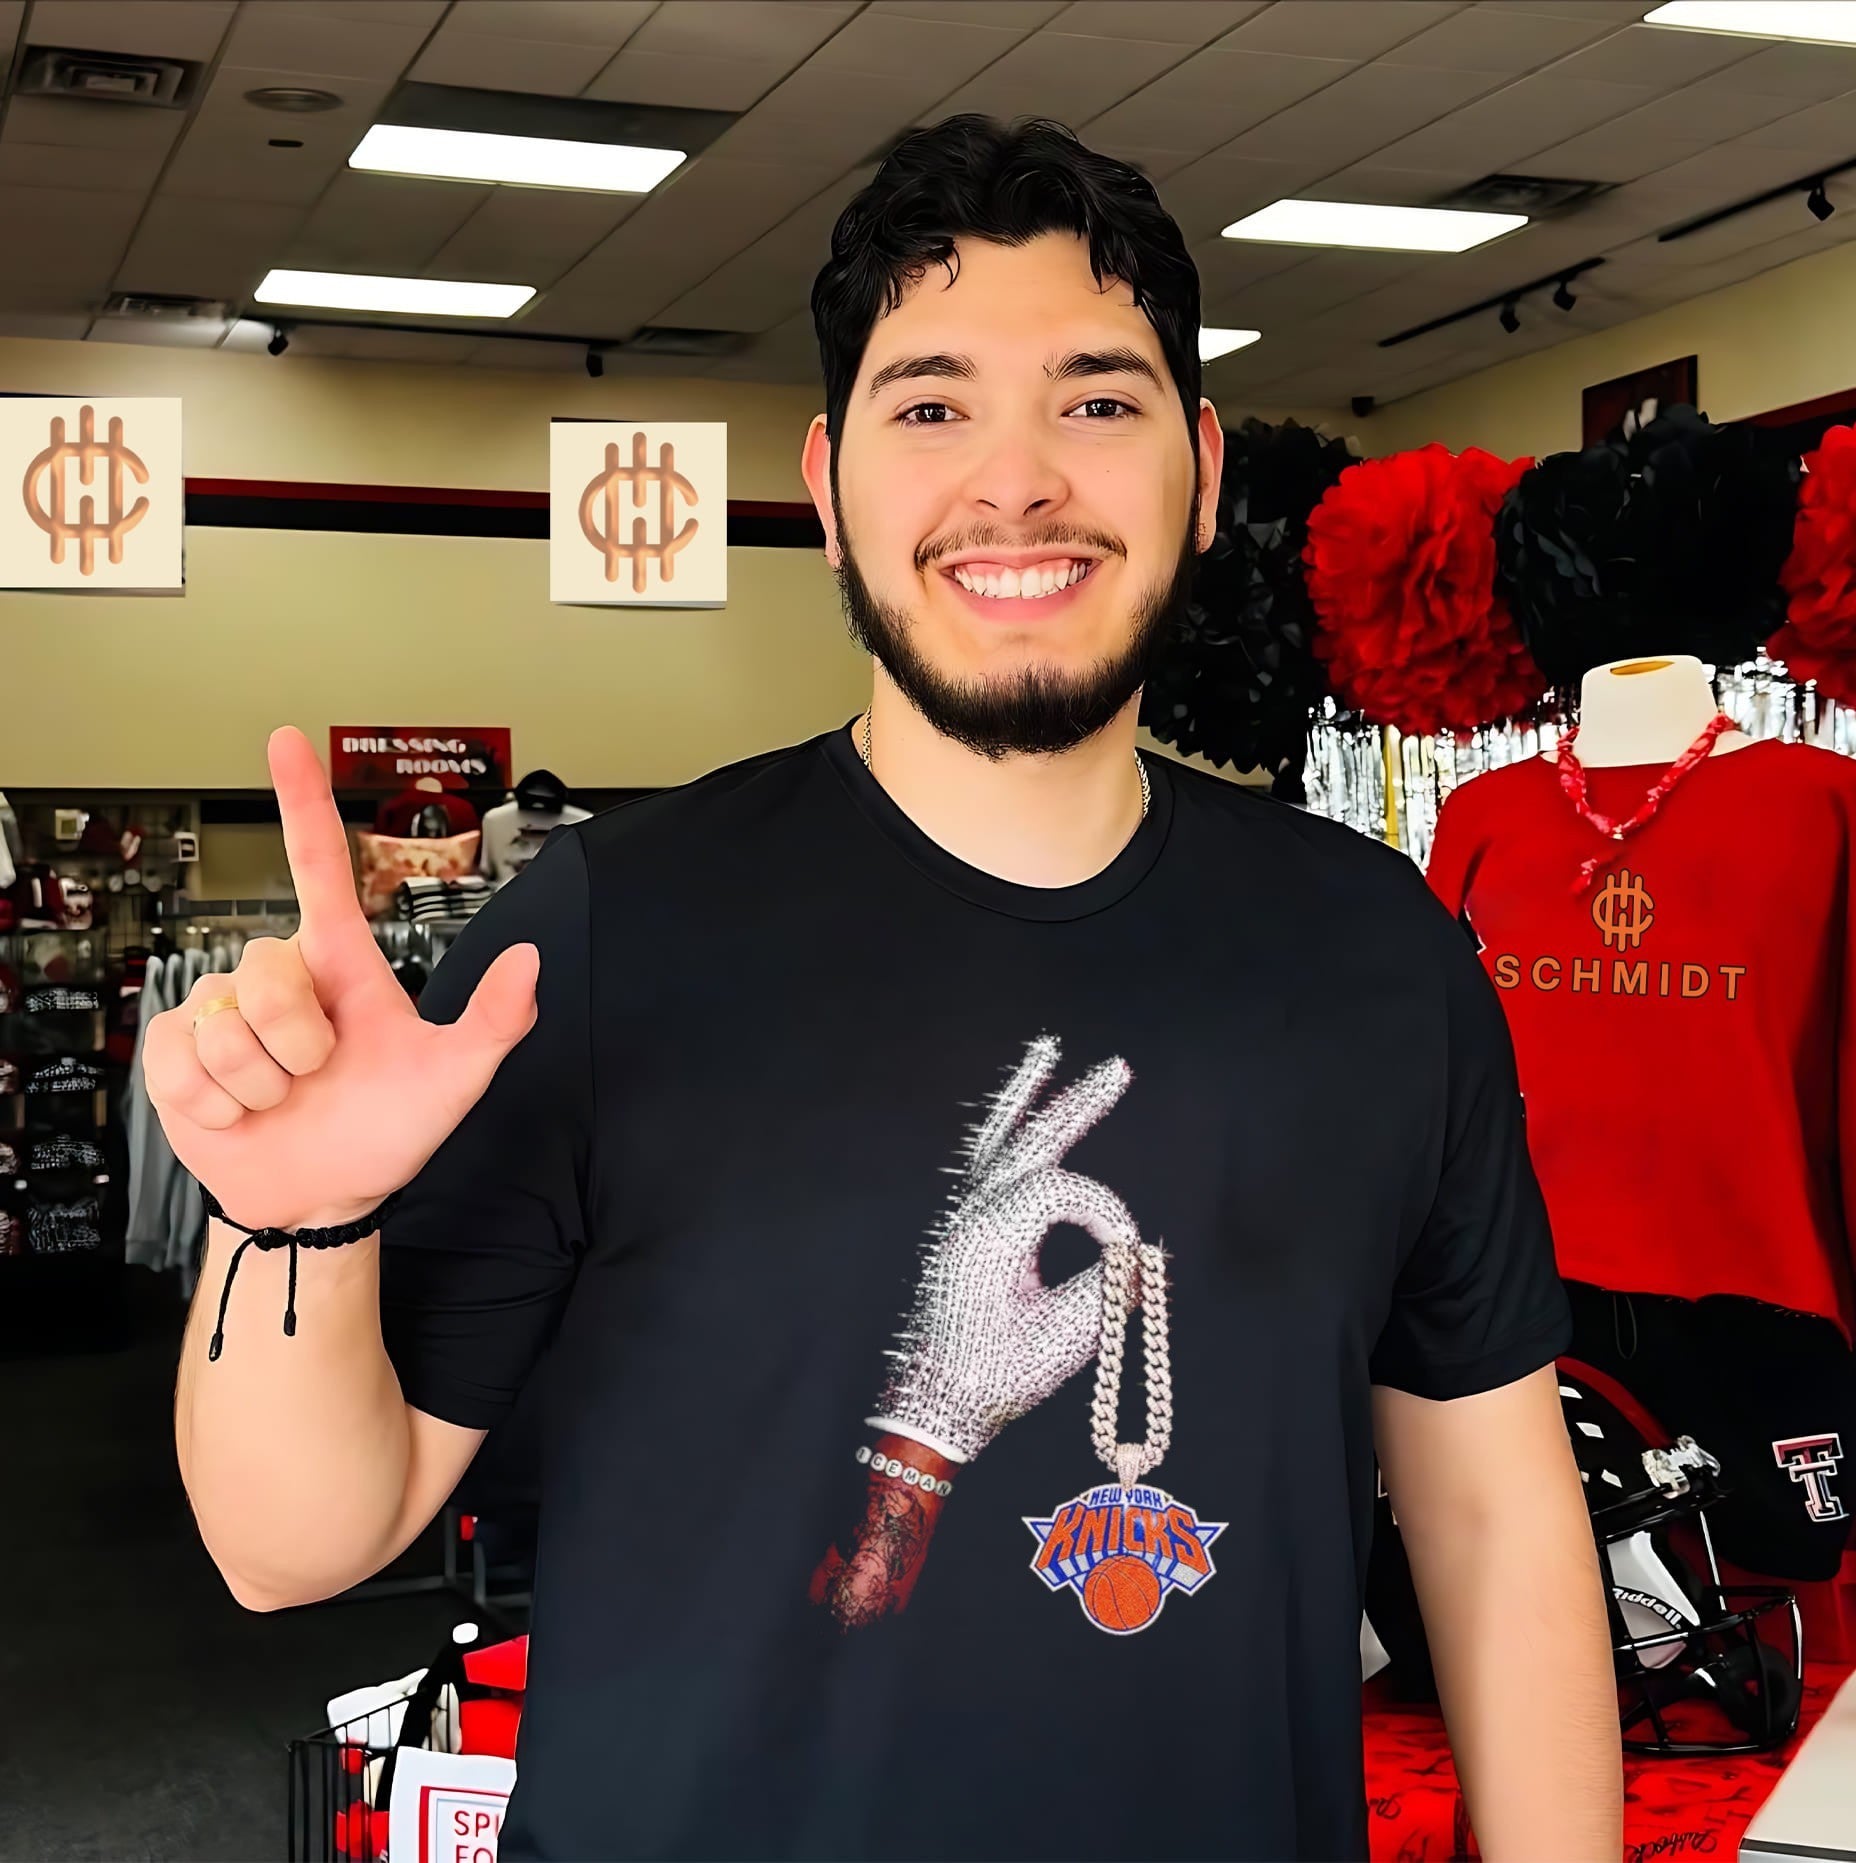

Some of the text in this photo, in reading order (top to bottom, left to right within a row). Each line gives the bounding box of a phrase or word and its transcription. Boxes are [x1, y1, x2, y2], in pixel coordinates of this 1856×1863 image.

[342, 737, 467, 754] DRESSING
[396, 758, 487, 775] ROOMS
[1494, 954, 1747, 1000] SCHMIDT
[858, 1447, 950, 1495] ICEMAN
[1089, 1487, 1163, 1508] NEW YORK
[1035, 1503, 1212, 1577] KNICKS
